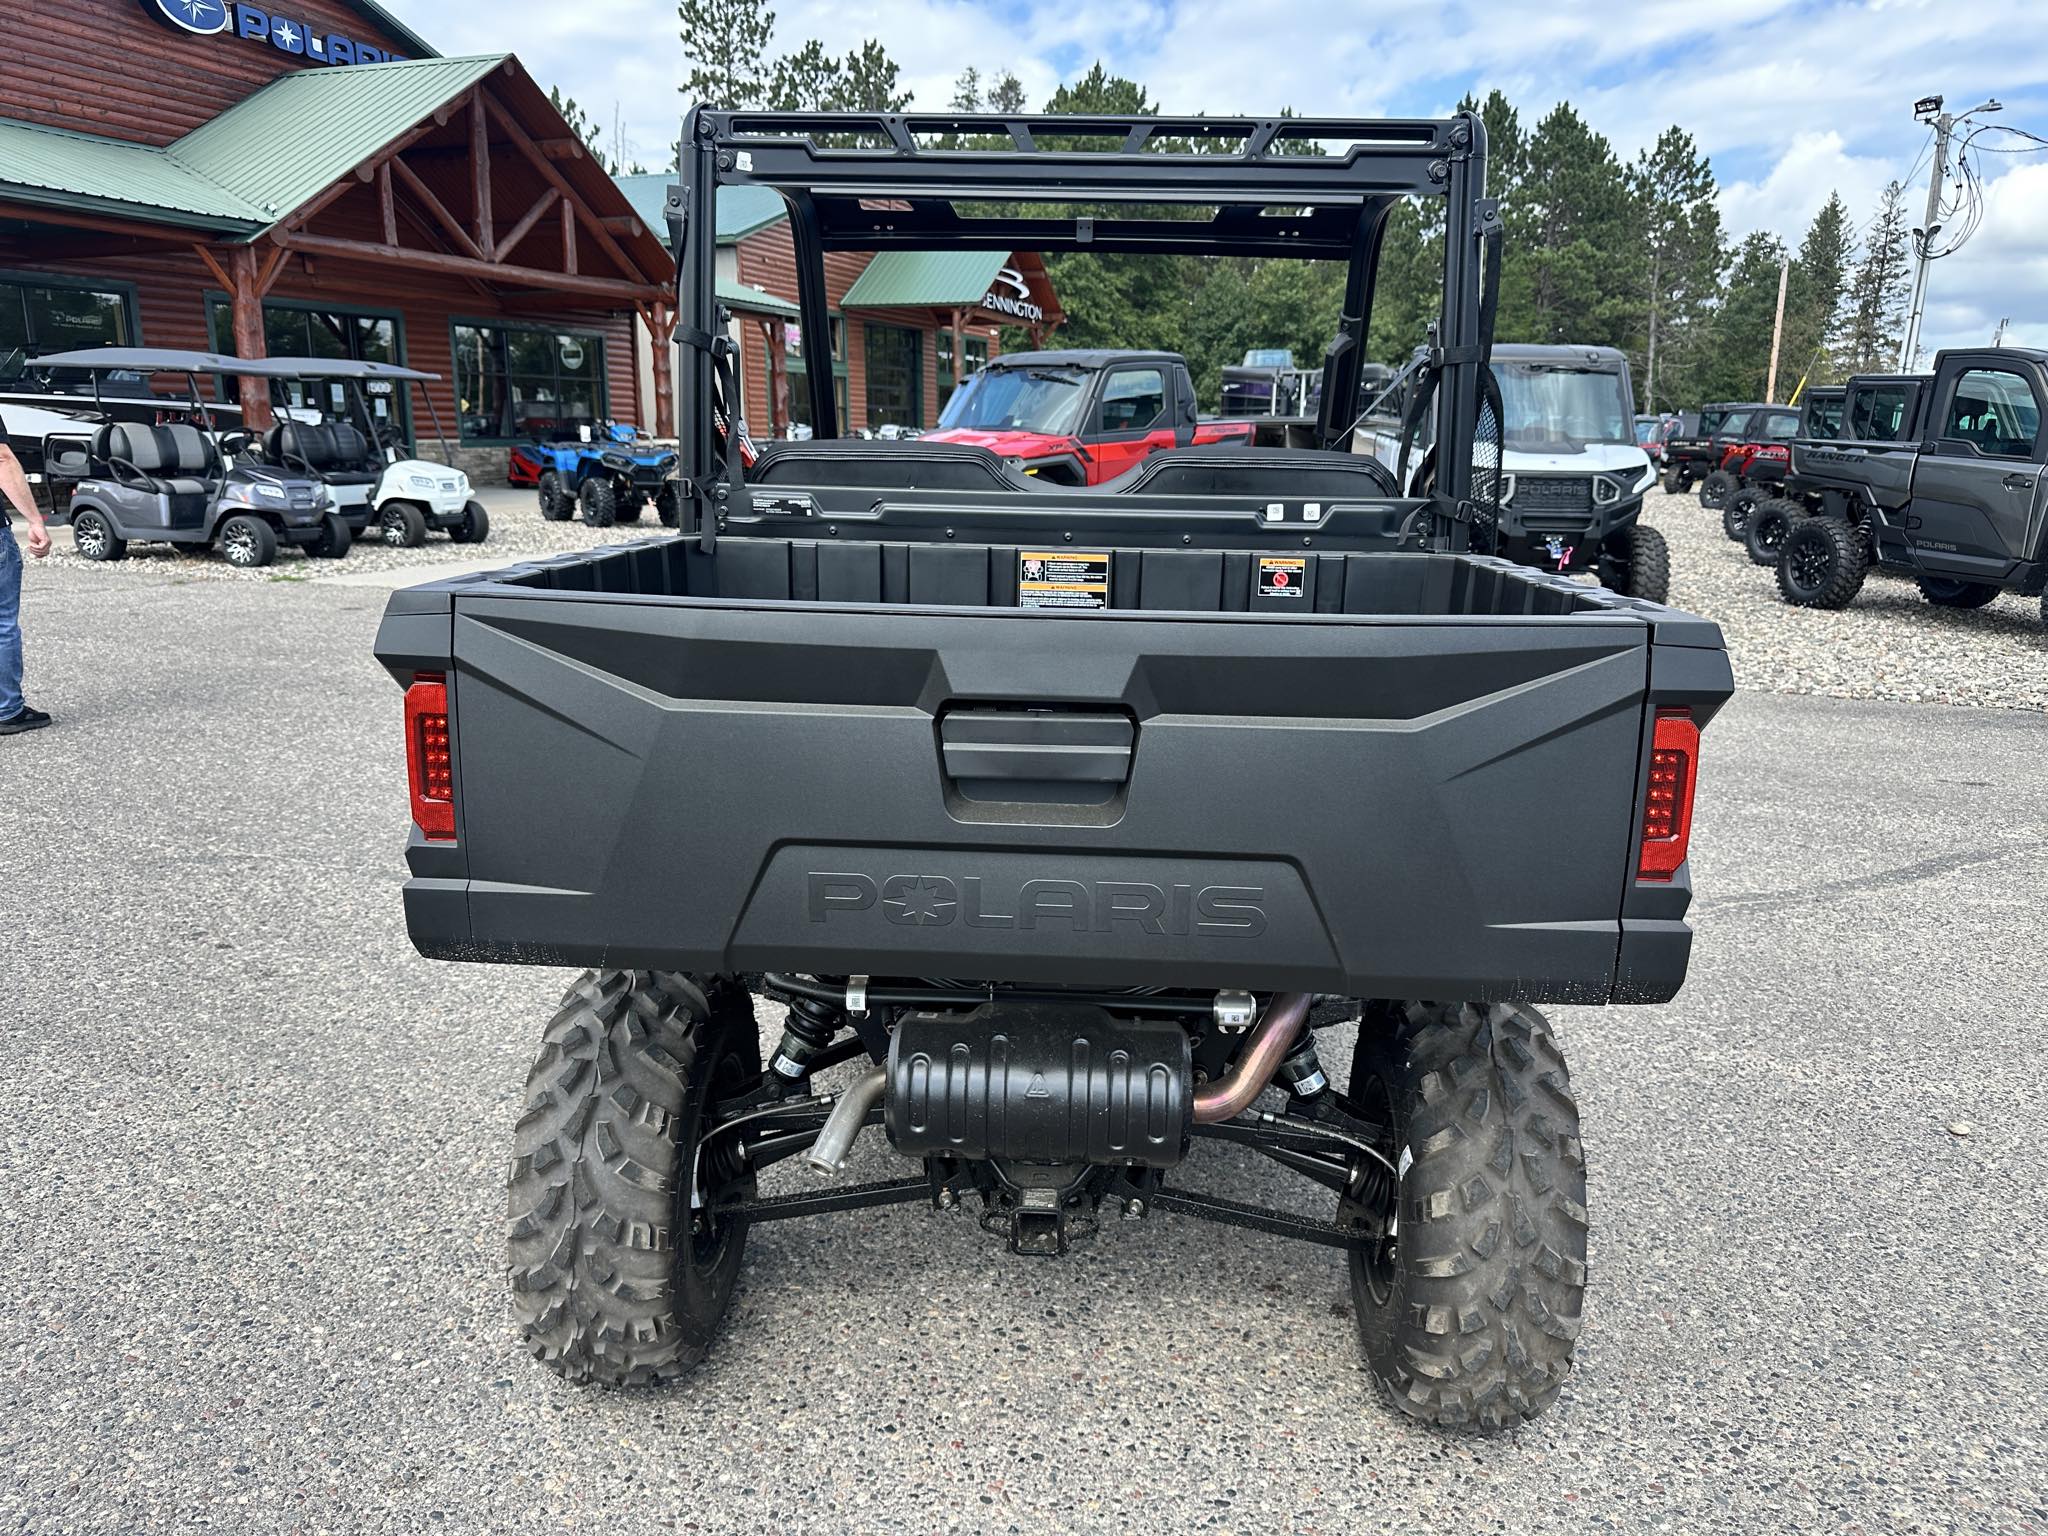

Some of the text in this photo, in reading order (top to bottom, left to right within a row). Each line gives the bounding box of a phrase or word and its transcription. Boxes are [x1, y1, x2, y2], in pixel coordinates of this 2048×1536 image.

[1807, 450, 1866, 463] RANGER
[1518, 485, 1587, 496] POLARIS
[1916, 539, 1957, 551] POLARIS
[808, 871, 1268, 938] POLARIS
